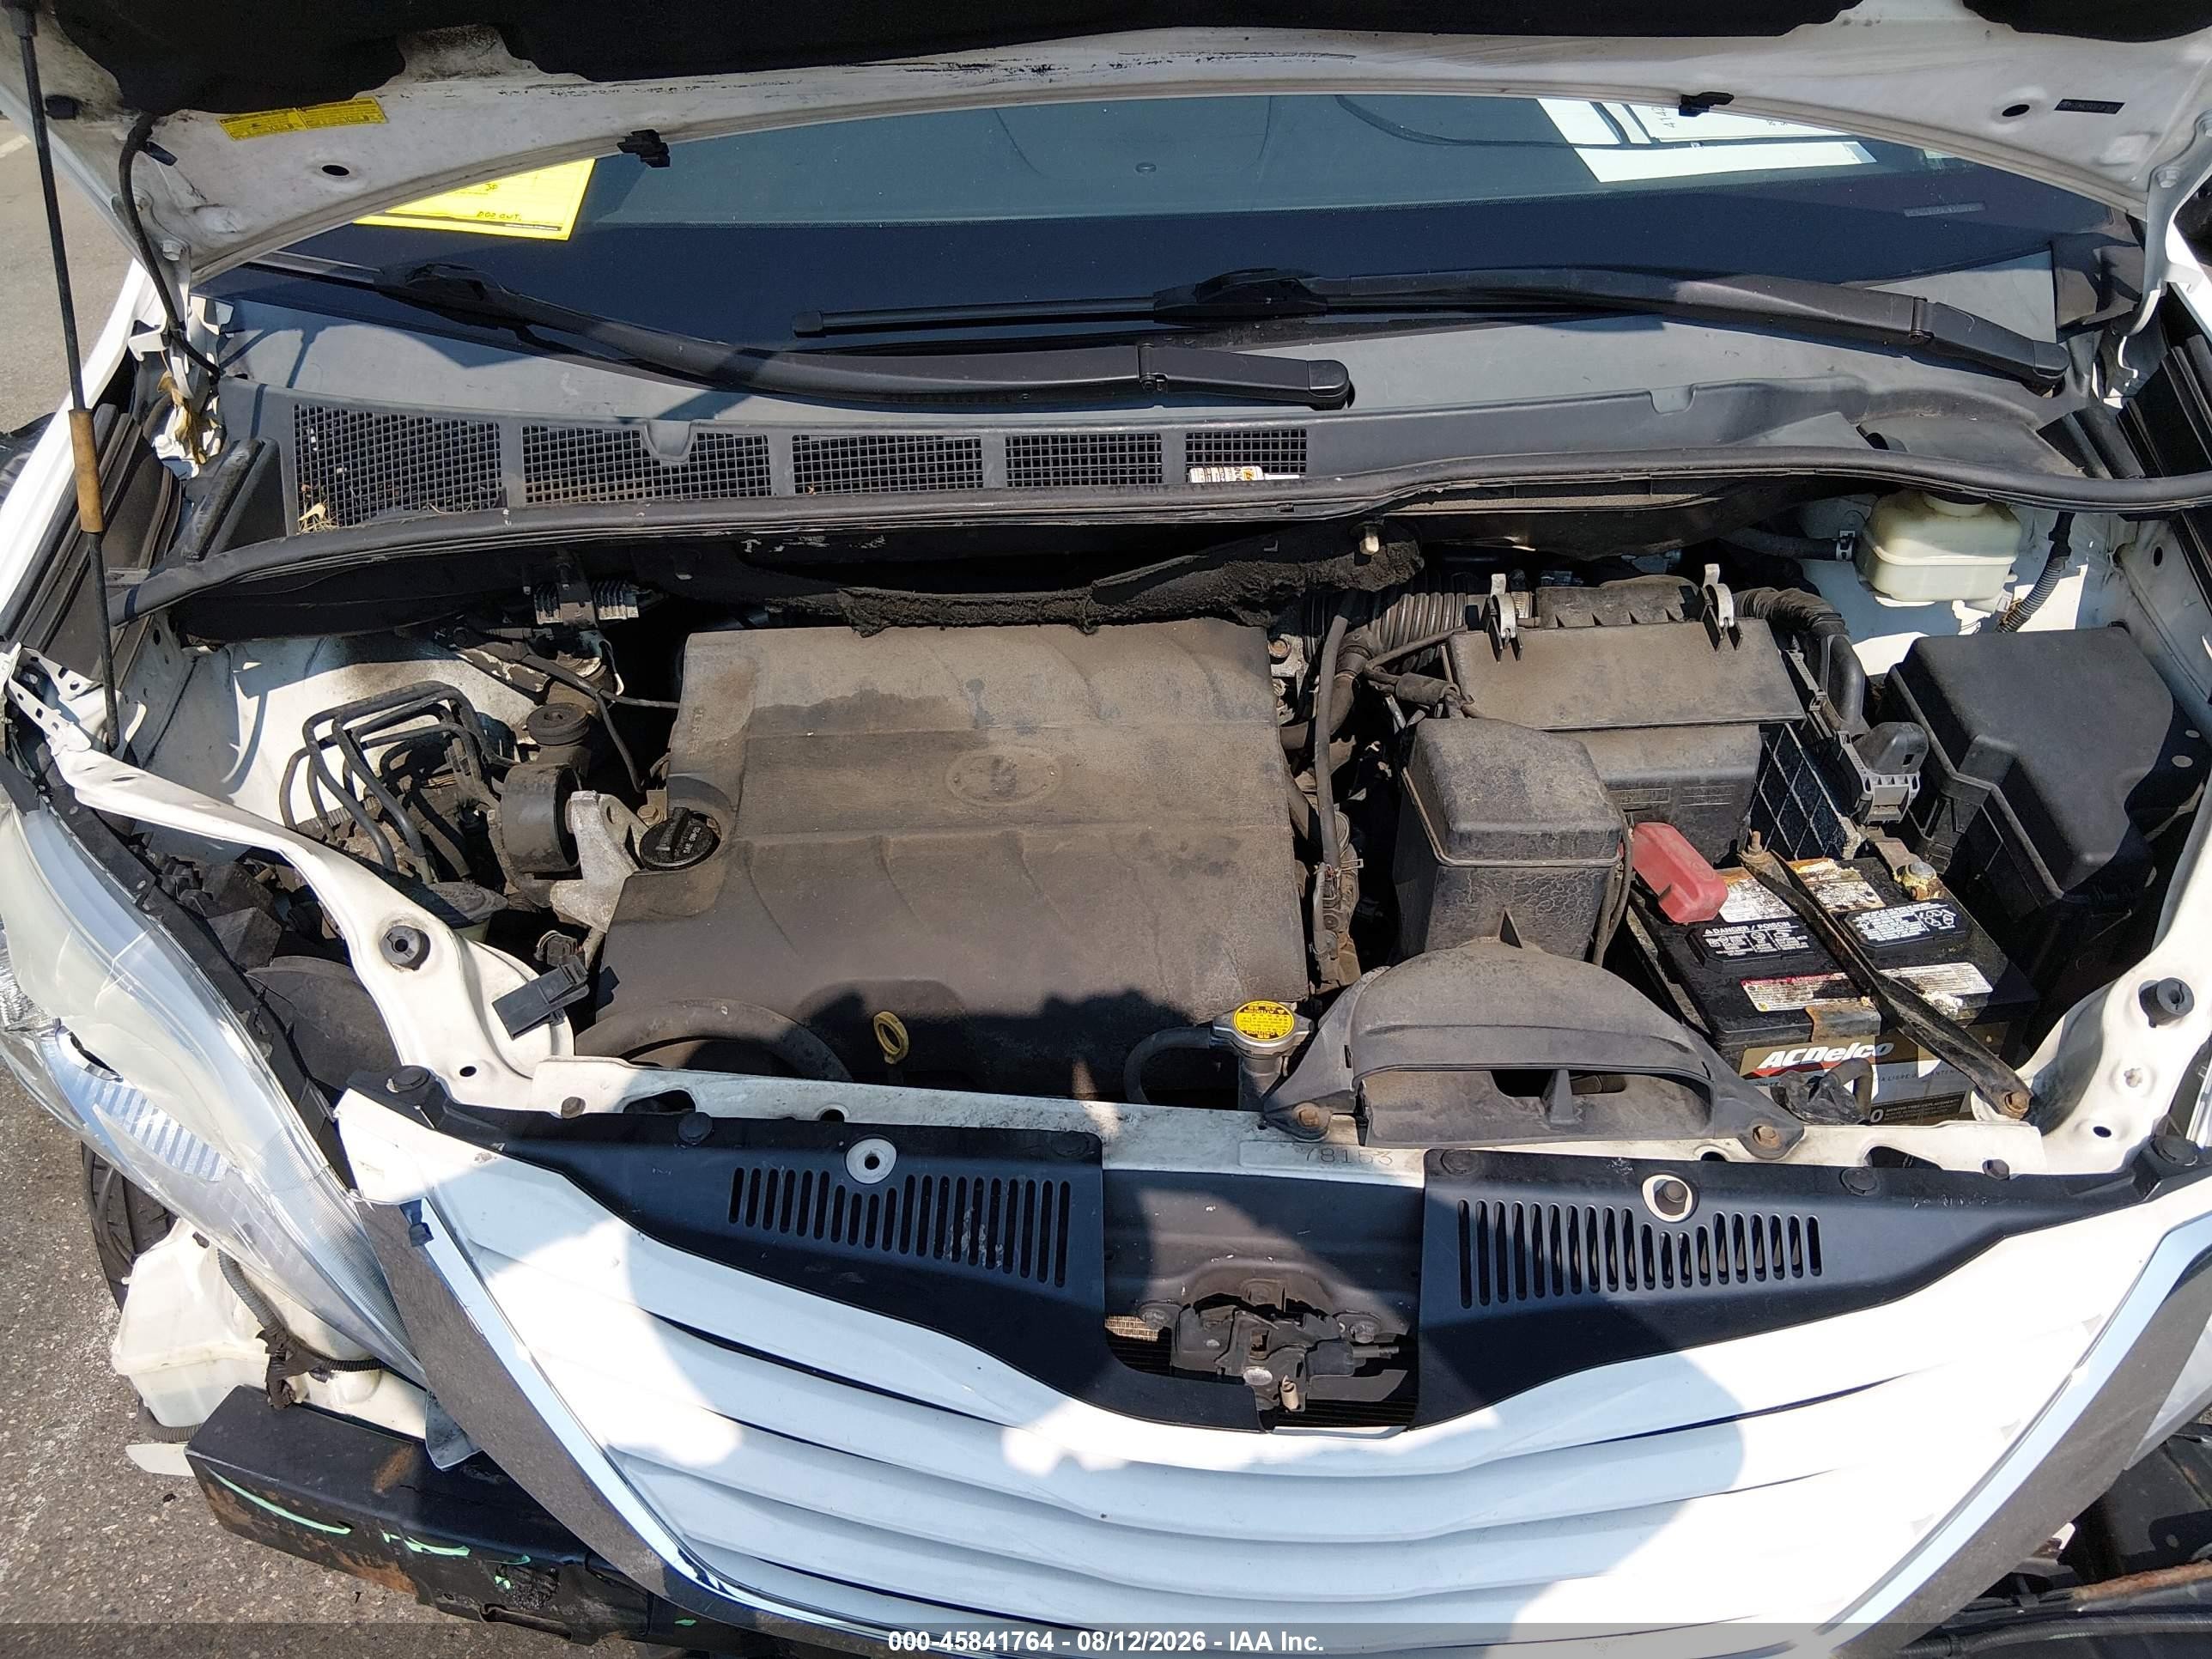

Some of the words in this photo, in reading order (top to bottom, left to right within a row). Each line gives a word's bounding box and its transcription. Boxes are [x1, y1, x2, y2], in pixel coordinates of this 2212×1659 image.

[1711, 925, 1749, 934] DANGER
[1758, 921, 1790, 930] POISON
[1757, 1042, 1894, 1069] ACDelco
